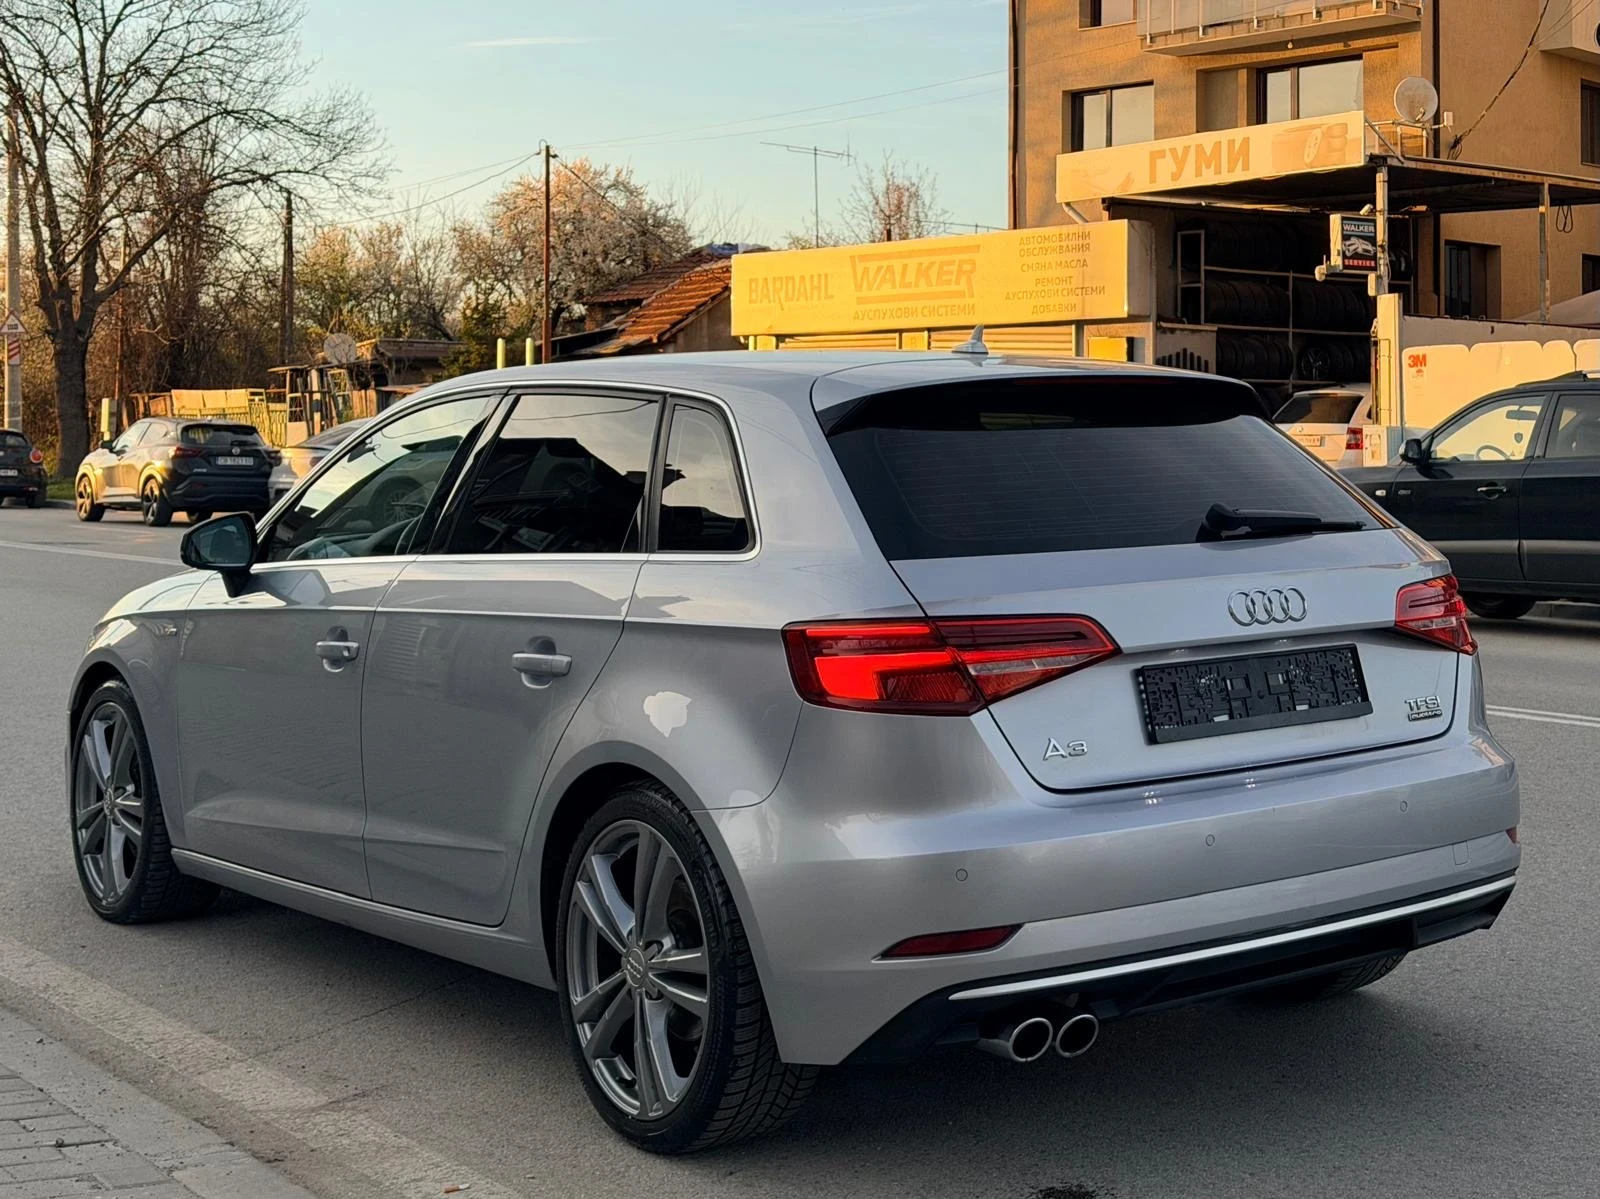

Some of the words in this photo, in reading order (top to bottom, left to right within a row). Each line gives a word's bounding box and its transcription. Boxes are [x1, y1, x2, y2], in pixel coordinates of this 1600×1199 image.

[1148, 137, 1250, 184] ГУМИ
[1343, 223, 1375, 233] WALKER
[1019, 231, 1090, 246] АВТОМОБИЛНИ
[1019, 243, 1090, 257] ОБСЛУЖВАНИЯ
[1021, 262, 1053, 272] СМЯНА
[1056, 259, 1088, 269] МАСЛА
[850, 256, 977, 298] WALKER
[1035, 276, 1073, 286] РЕМОНТ
[748, 272, 835, 311] BARDAHL
[1005, 290, 1058, 300] АУСПУХОВИ
[1061, 286, 1105, 296] СИСТЕМИ
[853, 306, 918, 321] АУСПУХОВИ
[920, 303, 976, 317] СИСТЕМИ
[1032, 304, 1076, 315] ДОБАВКИ
[1408, 353, 1427, 368] 3M
[1405, 696, 1441, 711] TFSI
[1043, 737, 1088, 761] A3
